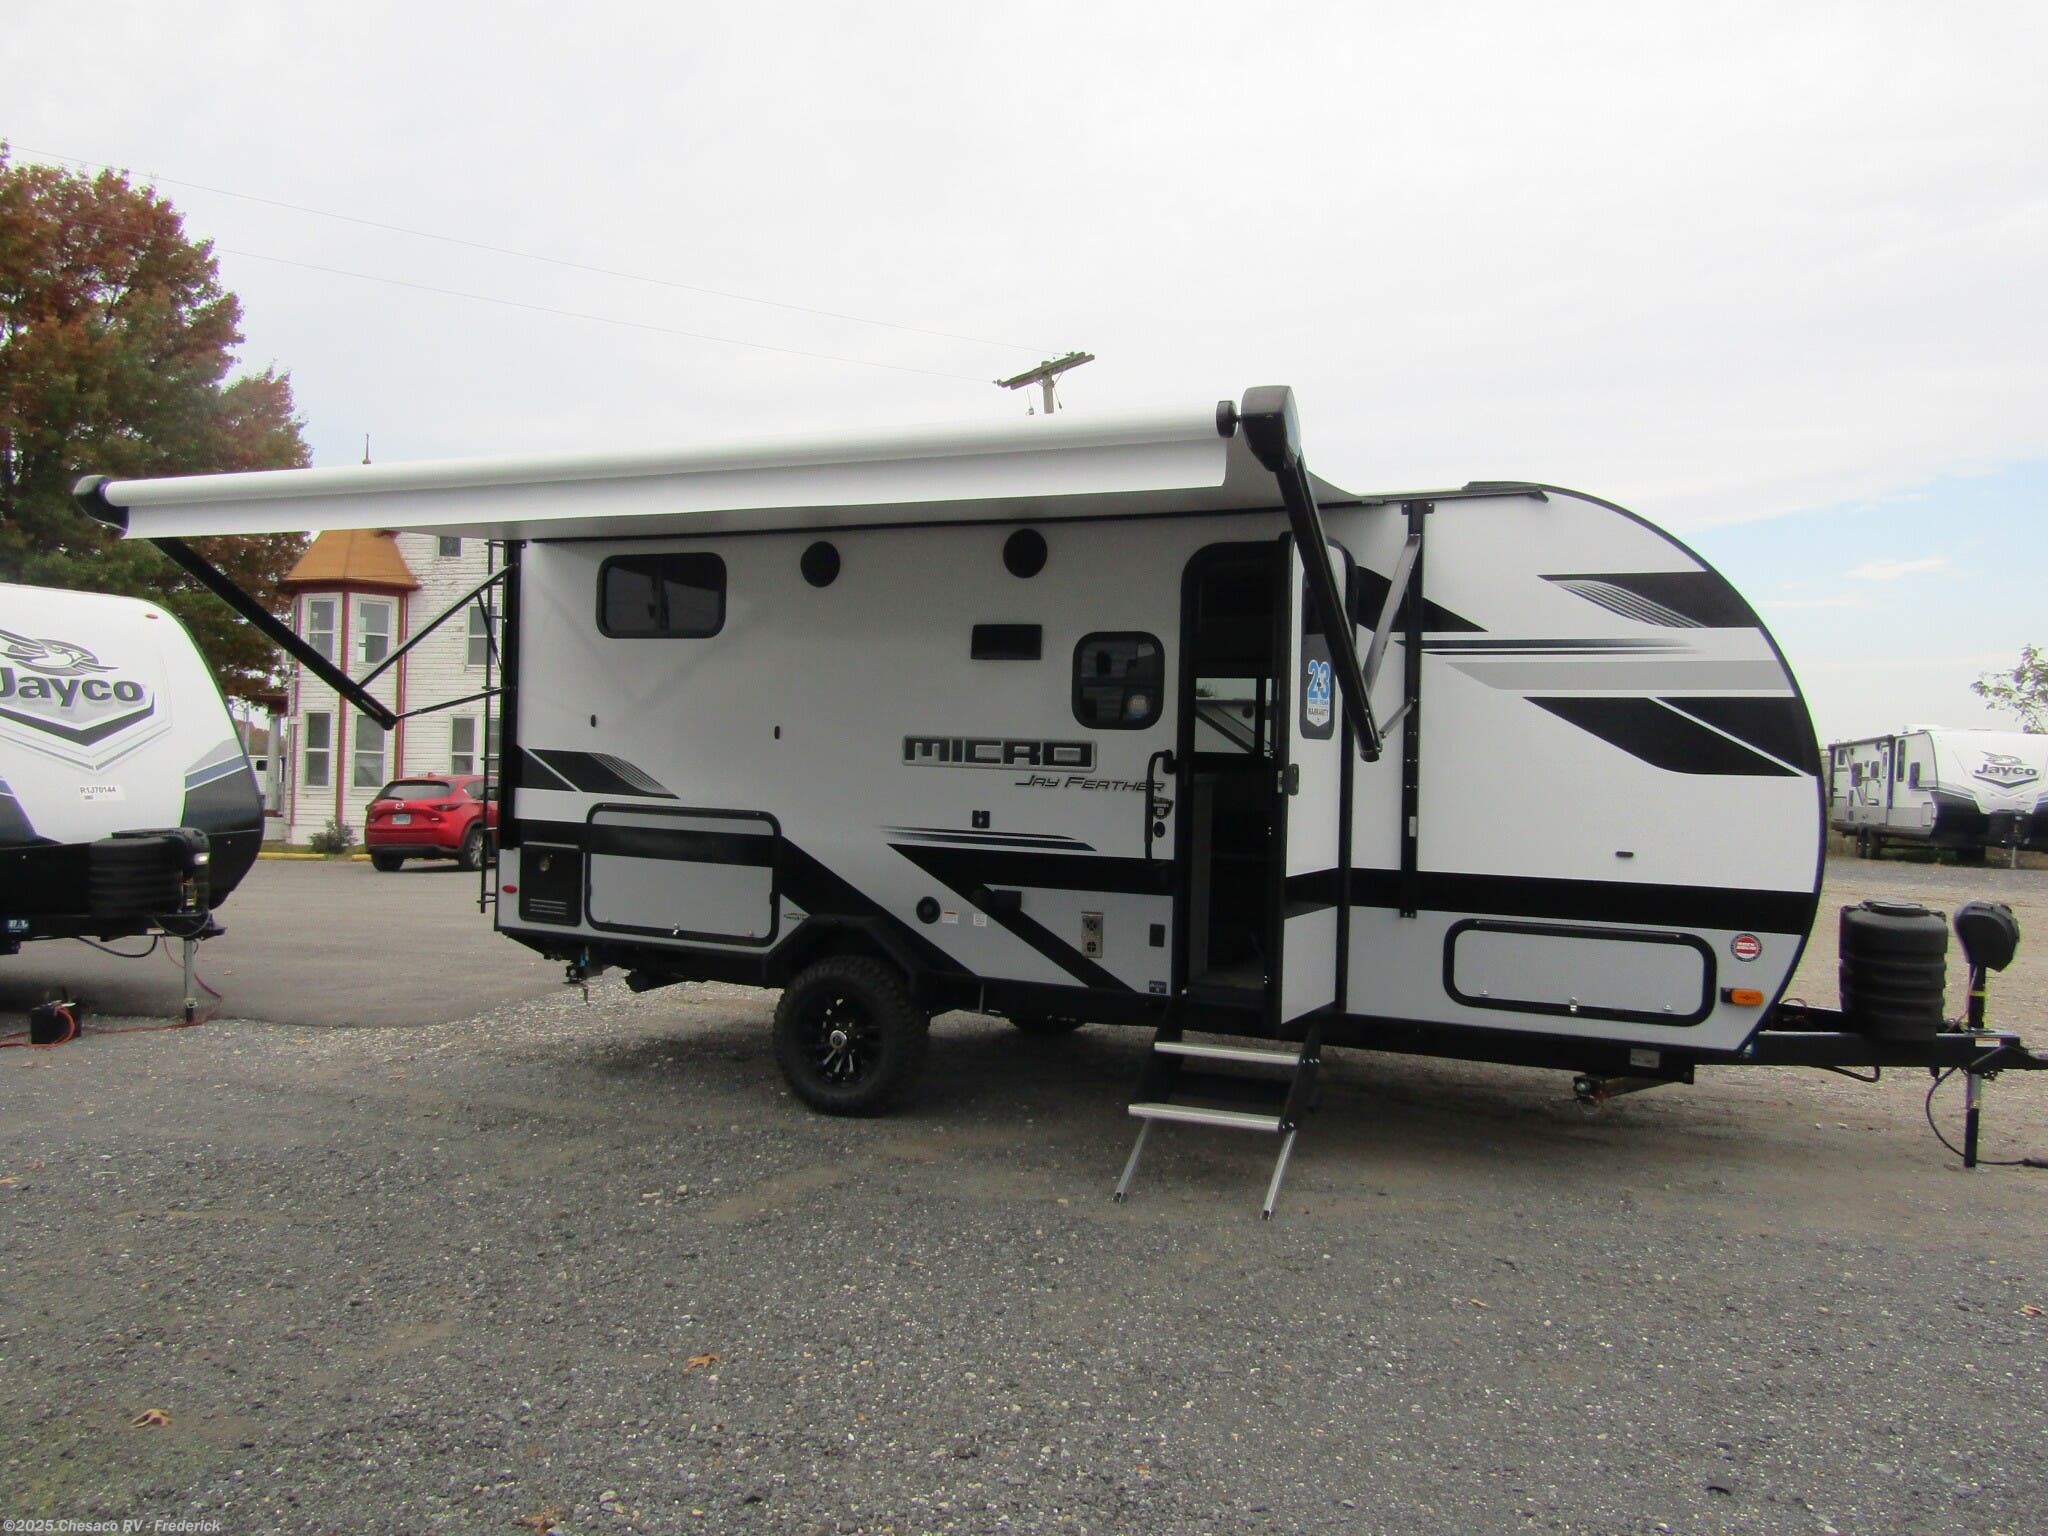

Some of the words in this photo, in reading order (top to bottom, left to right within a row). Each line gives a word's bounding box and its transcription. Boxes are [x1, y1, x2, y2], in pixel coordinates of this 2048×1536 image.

[0, 667, 144, 707] Jayco
[905, 738, 1092, 767] MICRO
[1975, 764, 2037, 776] Jayco
